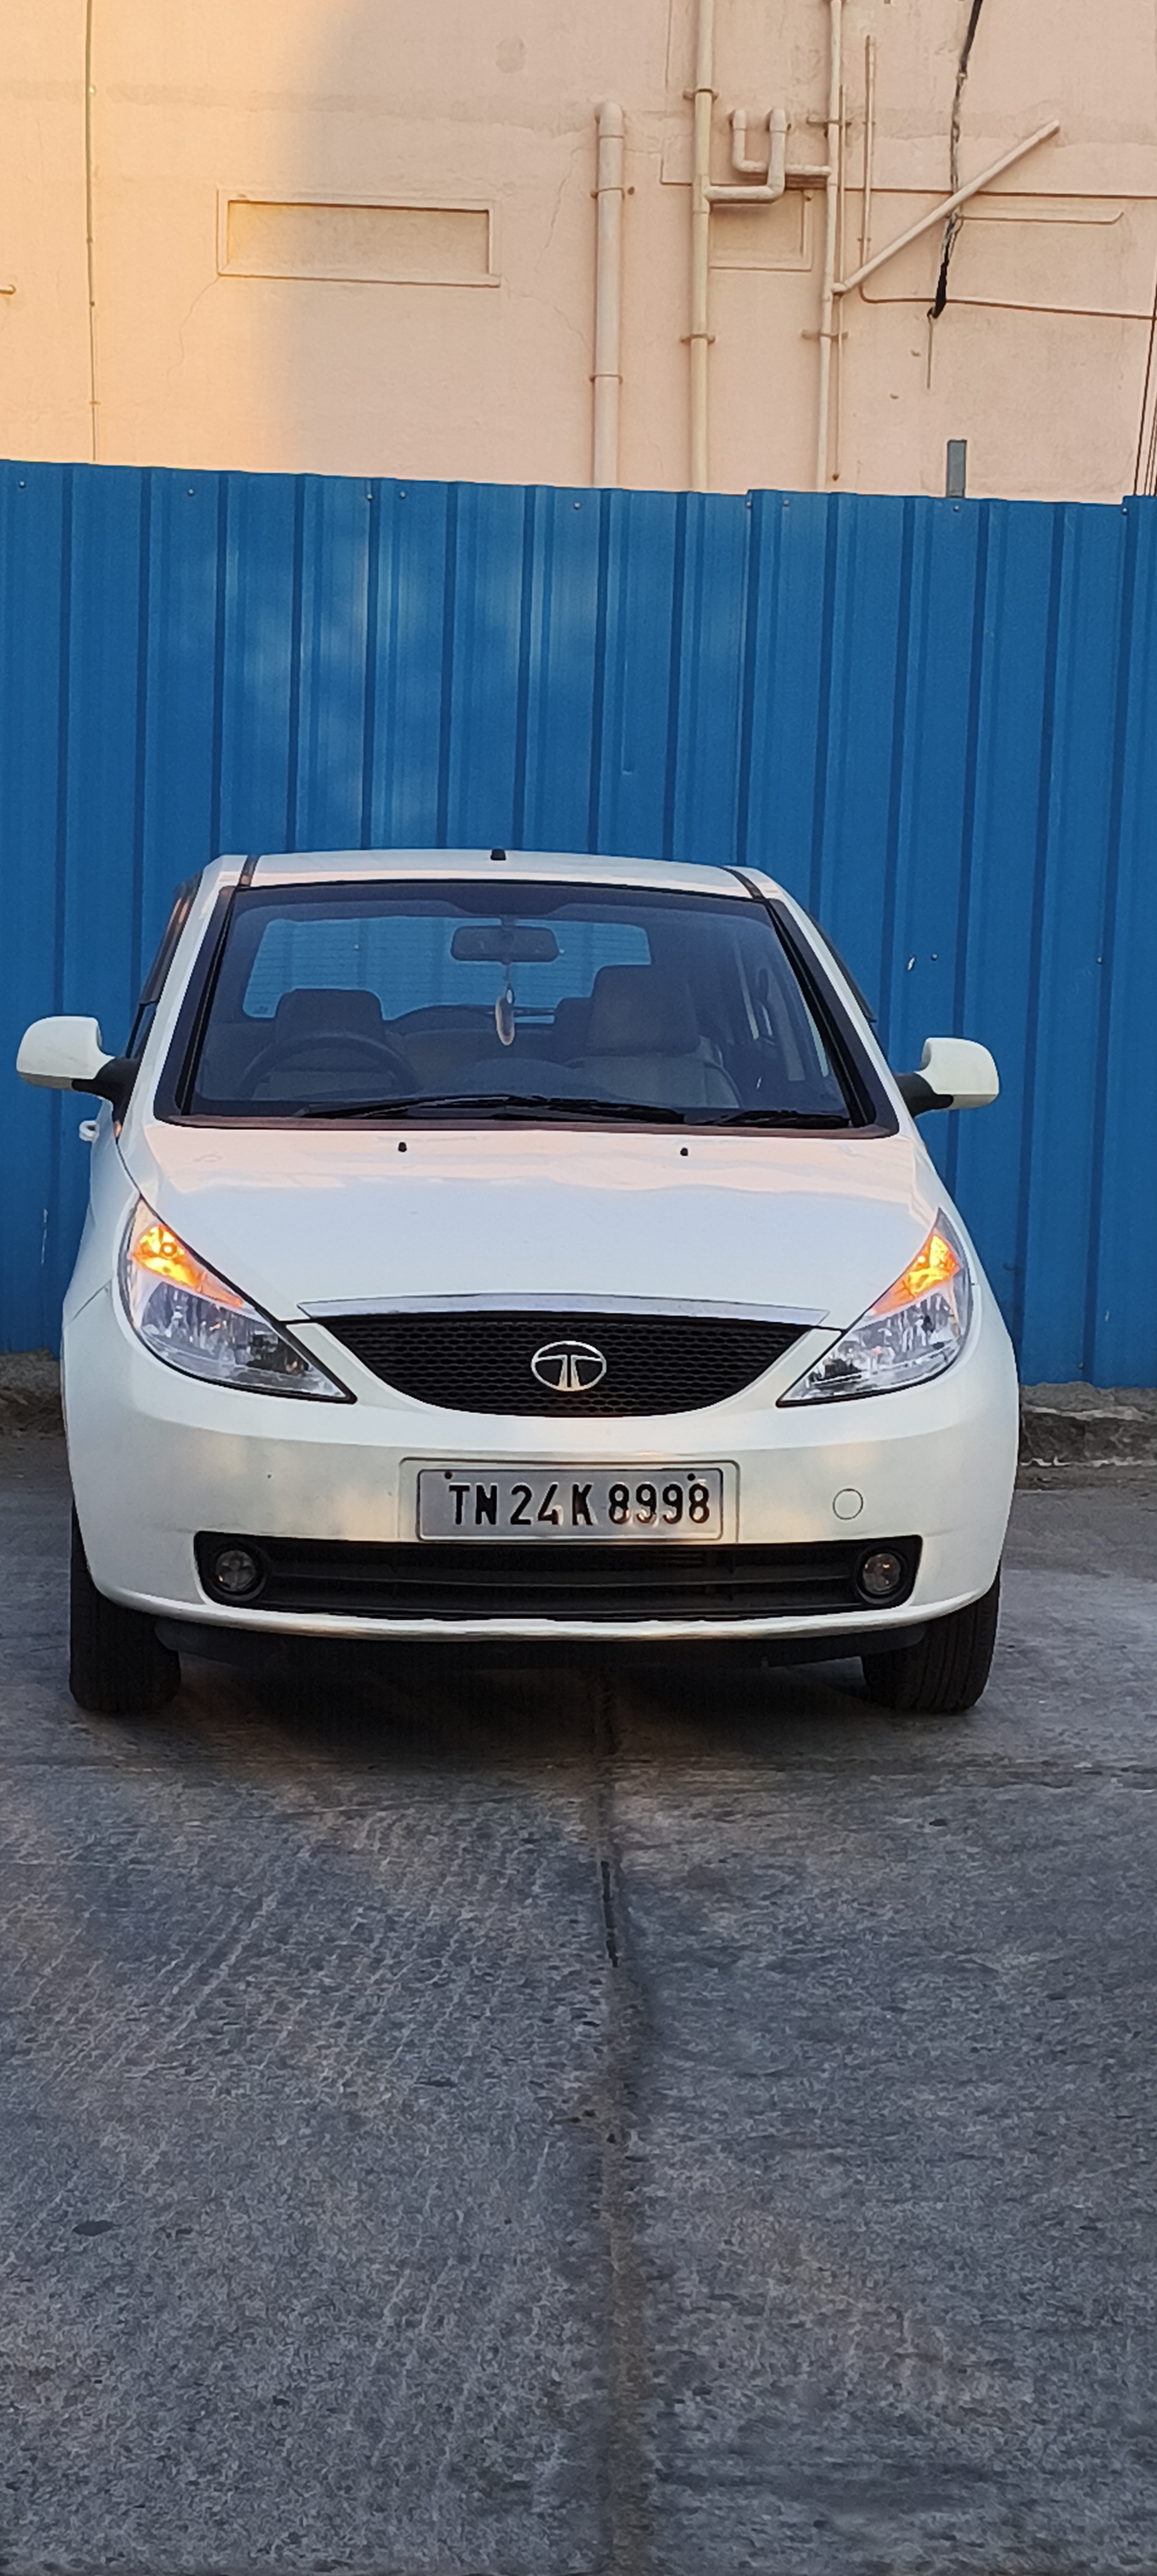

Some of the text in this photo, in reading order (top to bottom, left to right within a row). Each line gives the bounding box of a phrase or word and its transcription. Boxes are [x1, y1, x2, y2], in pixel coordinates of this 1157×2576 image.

[448, 1482, 710, 1526] TN 24 K 8998
